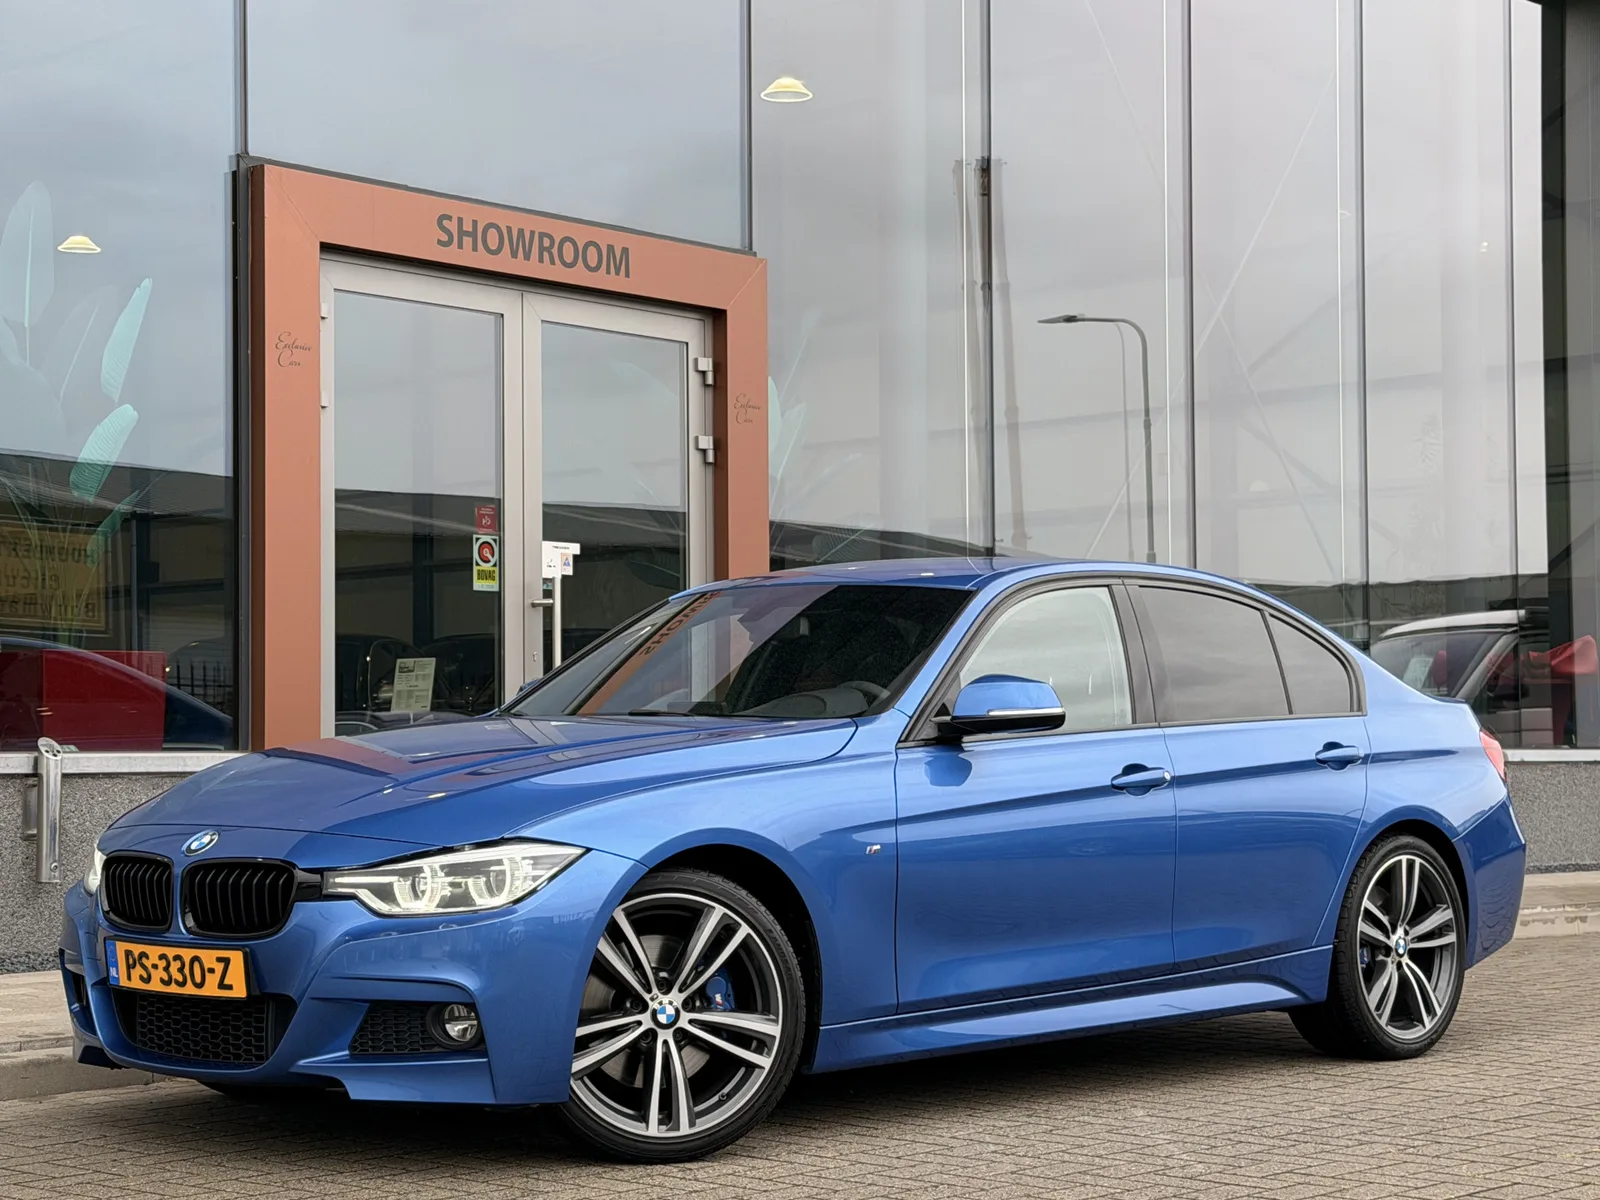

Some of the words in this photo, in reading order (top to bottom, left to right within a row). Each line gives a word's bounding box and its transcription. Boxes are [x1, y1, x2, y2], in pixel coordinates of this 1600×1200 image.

[436, 213, 631, 279] SHOWROOM
[477, 569, 496, 582] BOVAG
[109, 966, 119, 978] NL
[124, 949, 234, 991] PS-330-Z
